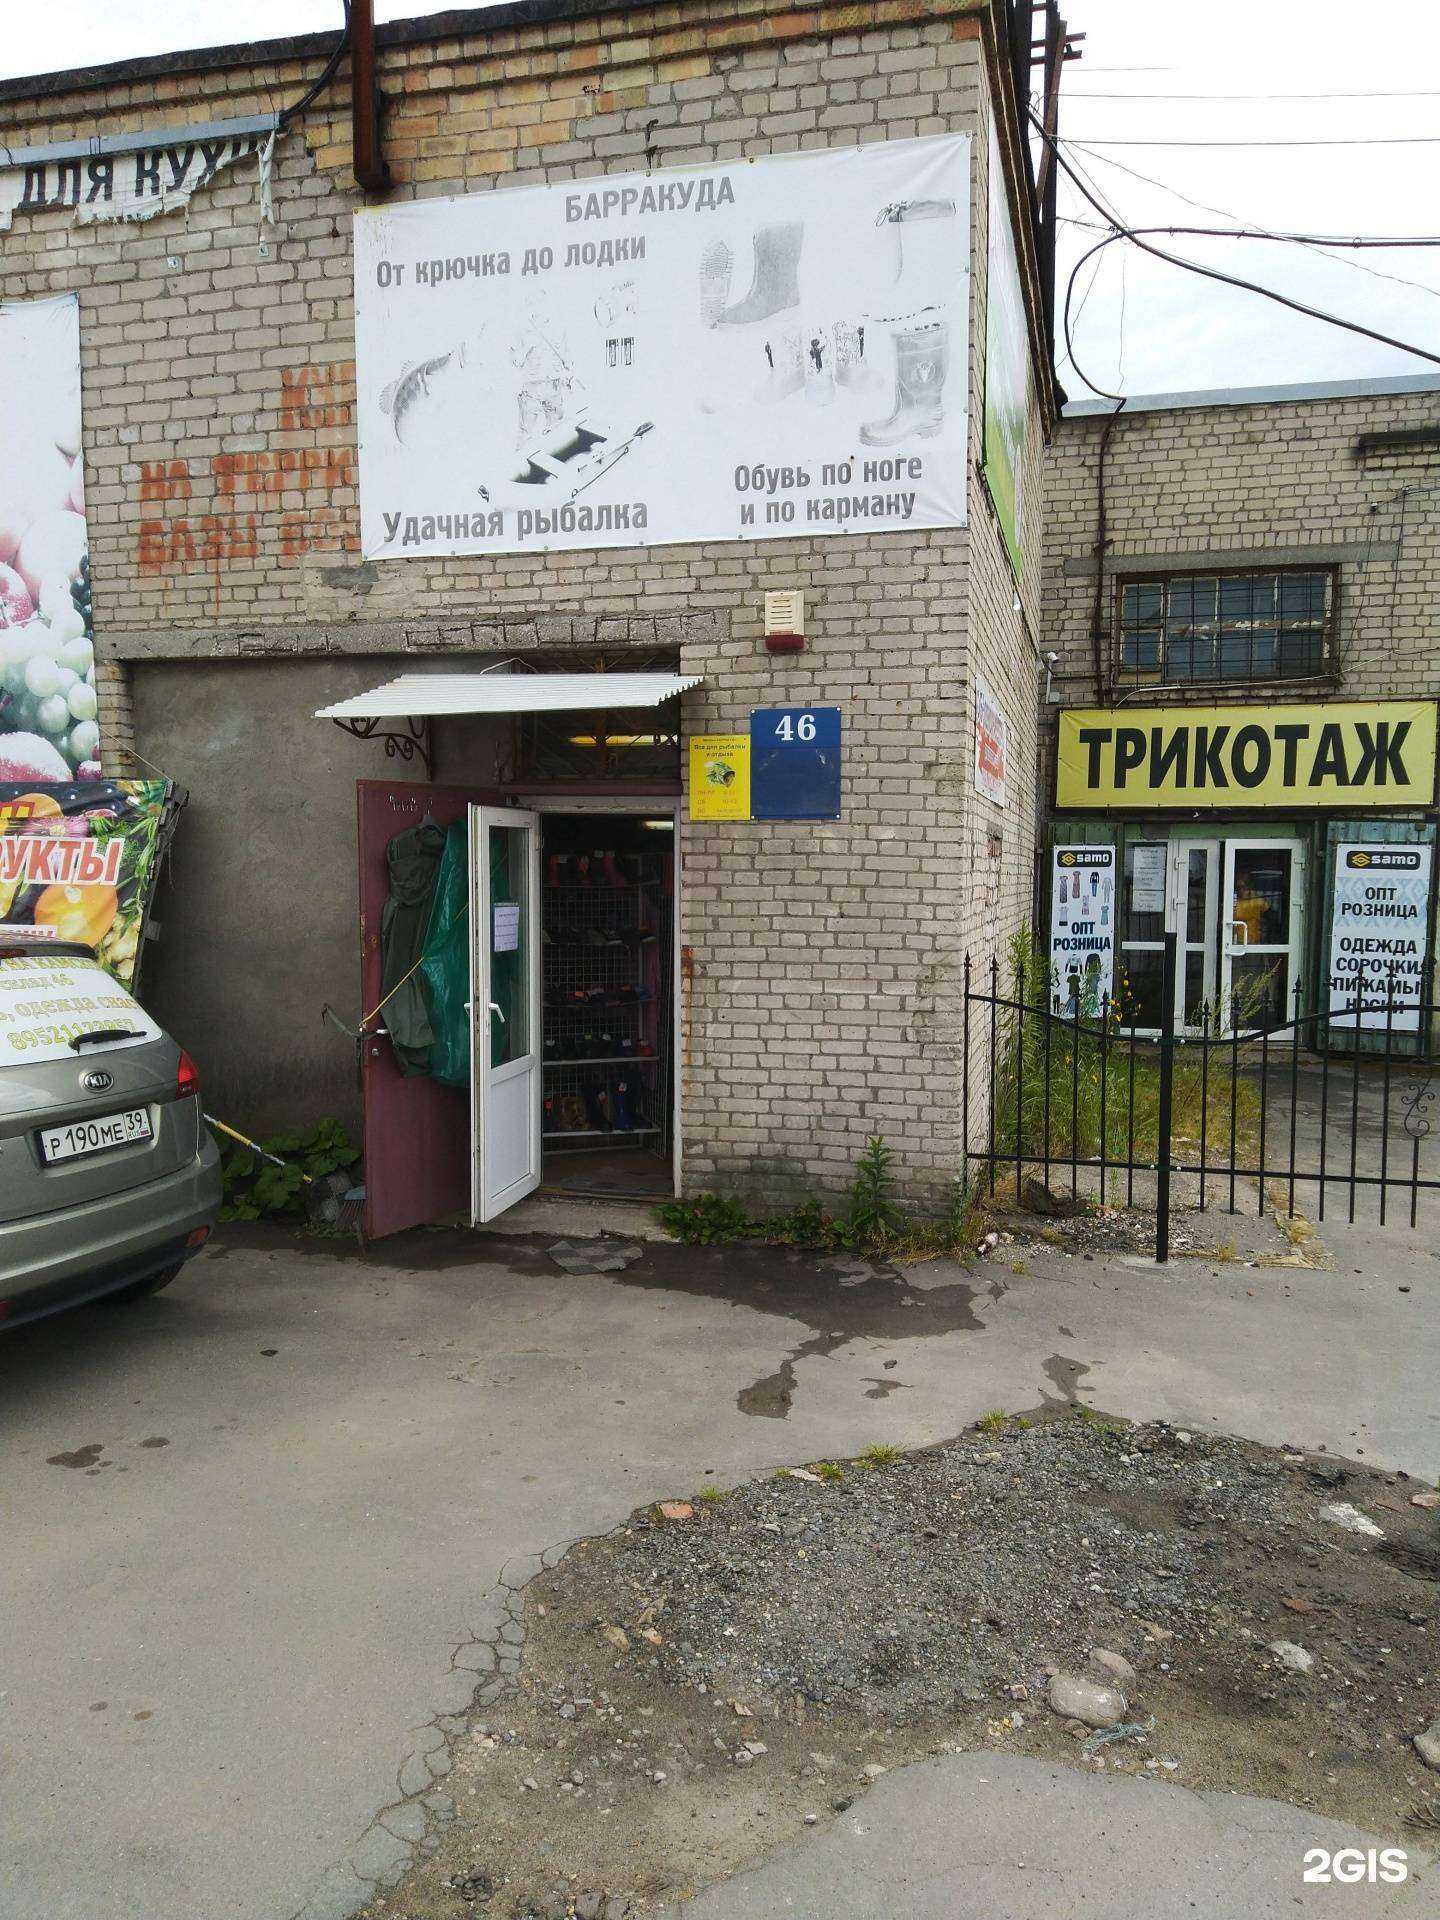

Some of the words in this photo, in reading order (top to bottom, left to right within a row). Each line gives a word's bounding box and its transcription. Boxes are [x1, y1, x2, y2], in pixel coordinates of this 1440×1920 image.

[19, 158, 114, 207] ДЛЯ
[565, 176, 736, 223] БАРРАКУДА
[377, 260, 402, 288] От
[416, 251, 510, 288] крючка
[522, 246, 553, 273] до
[566, 236, 647, 268] лодки
[735, 463, 811, 494] Обувь
[823, 462, 852, 486] по
[864, 456, 922, 483] ноге
[741, 503, 755, 525] и
[767, 500, 795, 524] по
[807, 492, 916, 525] карману
[383, 510, 504, 548] Удачная
[517, 502, 649, 541] рыбалка
[774, 714, 817, 741] 46
[1079, 721, 1413, 789] ТРИКОТАЖ
[0, 838, 122, 883] УКТЫ
[1077, 853, 1110, 864] samo
[1371, 854, 1417, 866] samo
[1365, 887, 1397, 901] ОПТ
[1341, 903, 1418, 920] РОЗНИЦА
[1071, 921, 1096, 935] ОПТ
[1053, 937, 1112, 953] РОЗНИЦА
[1340, 937, 1418, 956] ОДЕЖДА
[1336, 957, 1420, 975] СОРОЧКИ
[89, 1074, 111, 1087] KIA
[126, 1112, 143, 1131] 39
